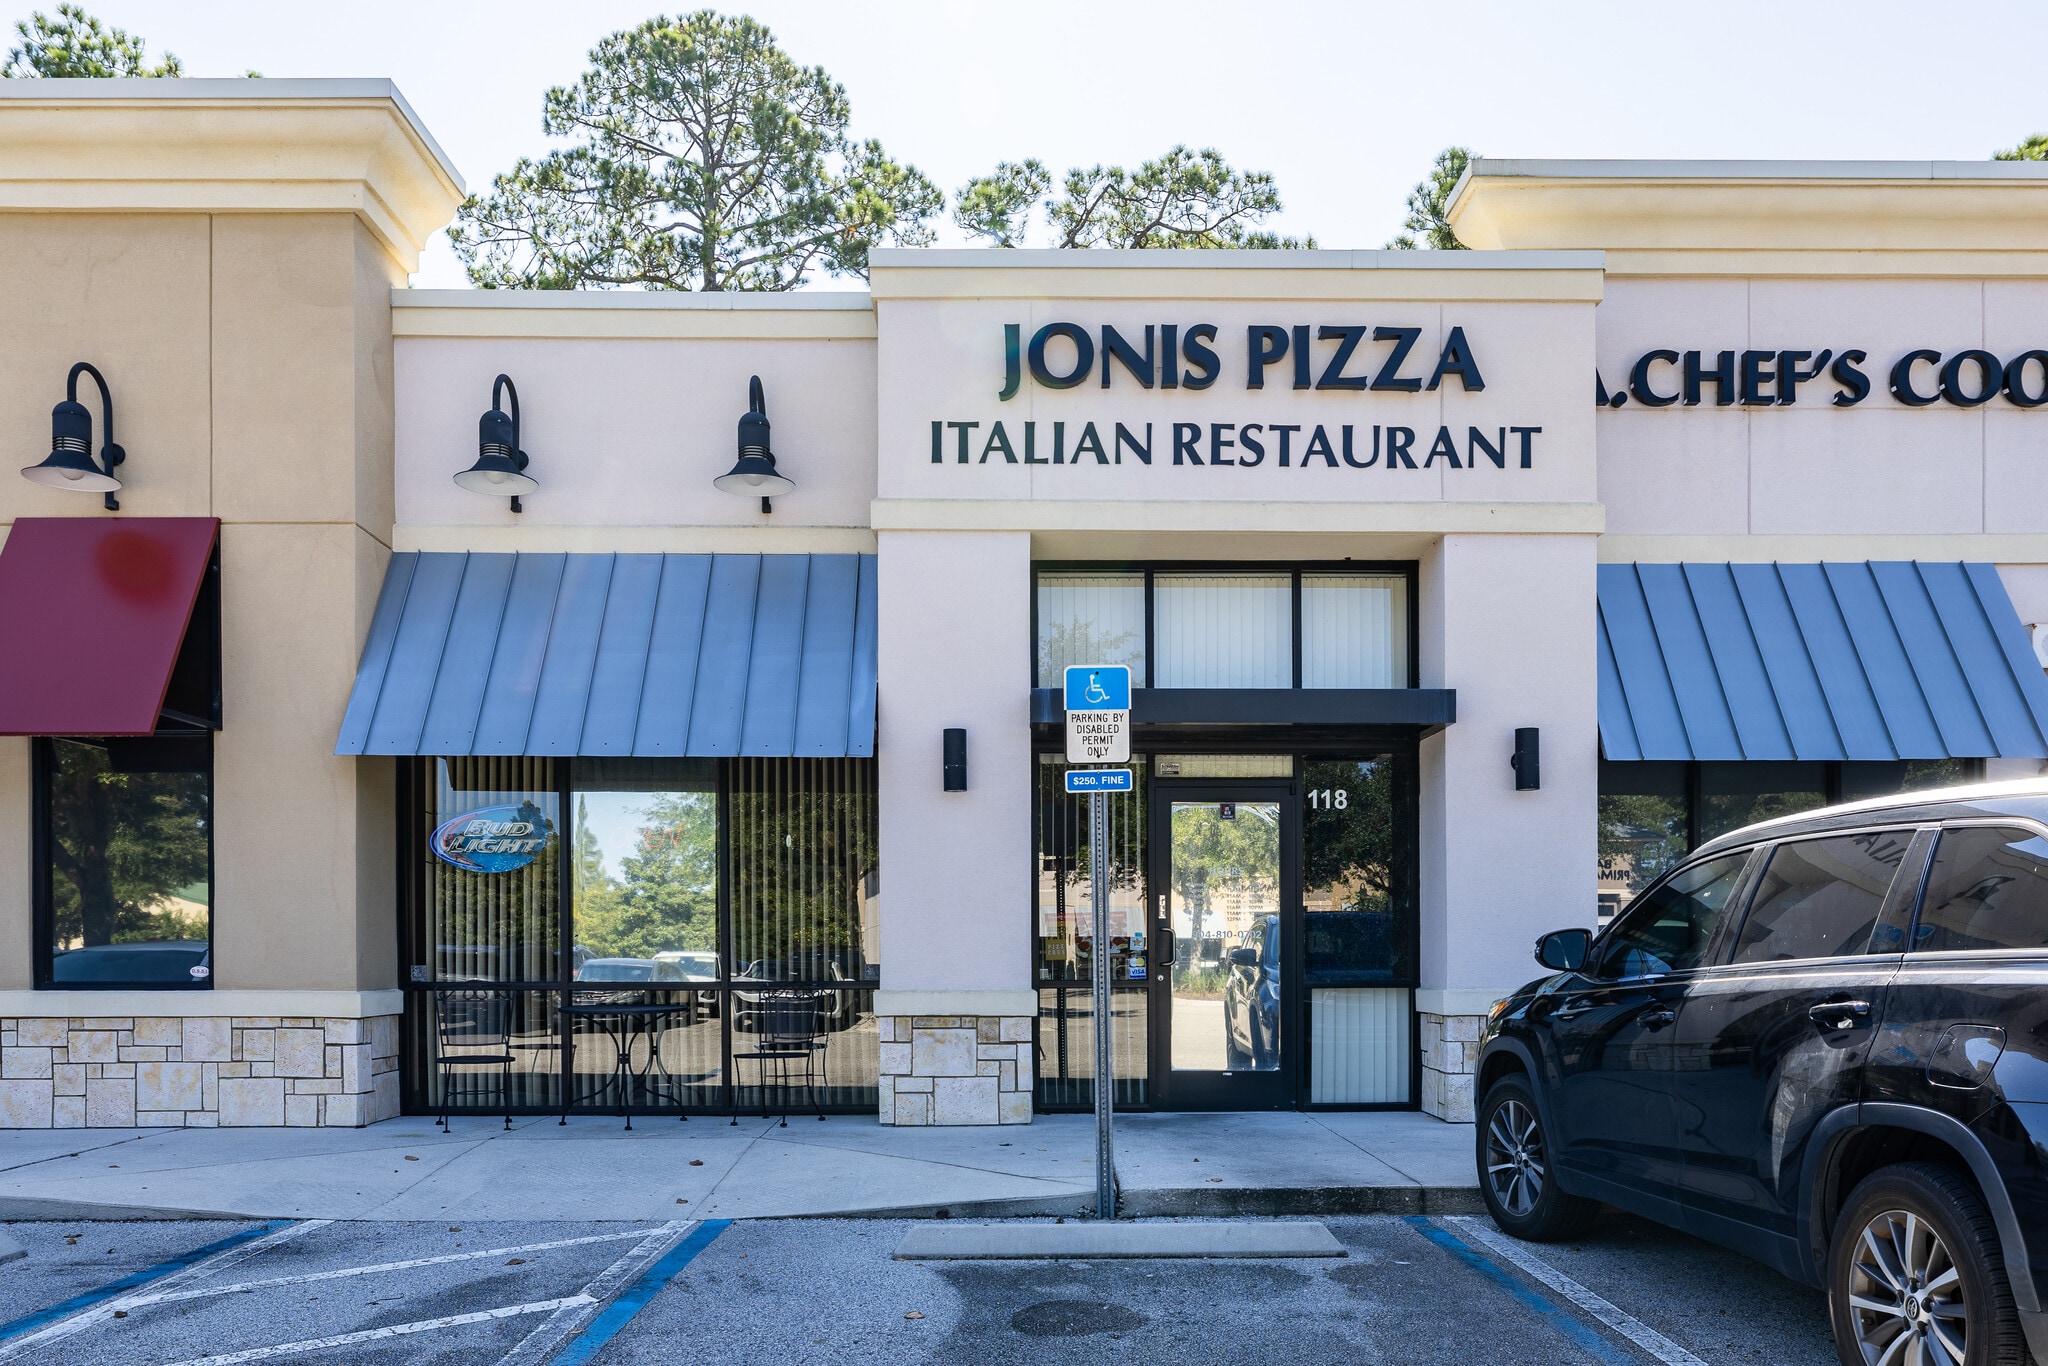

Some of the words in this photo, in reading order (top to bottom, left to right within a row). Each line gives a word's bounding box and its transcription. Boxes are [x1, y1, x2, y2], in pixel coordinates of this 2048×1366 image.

[998, 322, 1222, 402] JONIS
[1246, 324, 1486, 393] PIZZA
[1596, 348, 1871, 409] .CHEF'S
[931, 420, 1152, 465] ITALIAN
[1172, 422, 1542, 469] RESTAURANT
[1071, 713, 1108, 723] PARKING
[1113, 713, 1124, 723] BY
[1076, 724, 1120, 734] DISABLED
[1082, 735, 1114, 745] PERMIT
[1087, 747, 1109, 757] ONLY
[1073, 776, 1099, 785] $250.
[1102, 776, 1124, 785] FINE
[1307, 789, 1349, 810] 118
[464, 819, 535, 837] BUD
[446, 835, 542, 854] LIGHT
